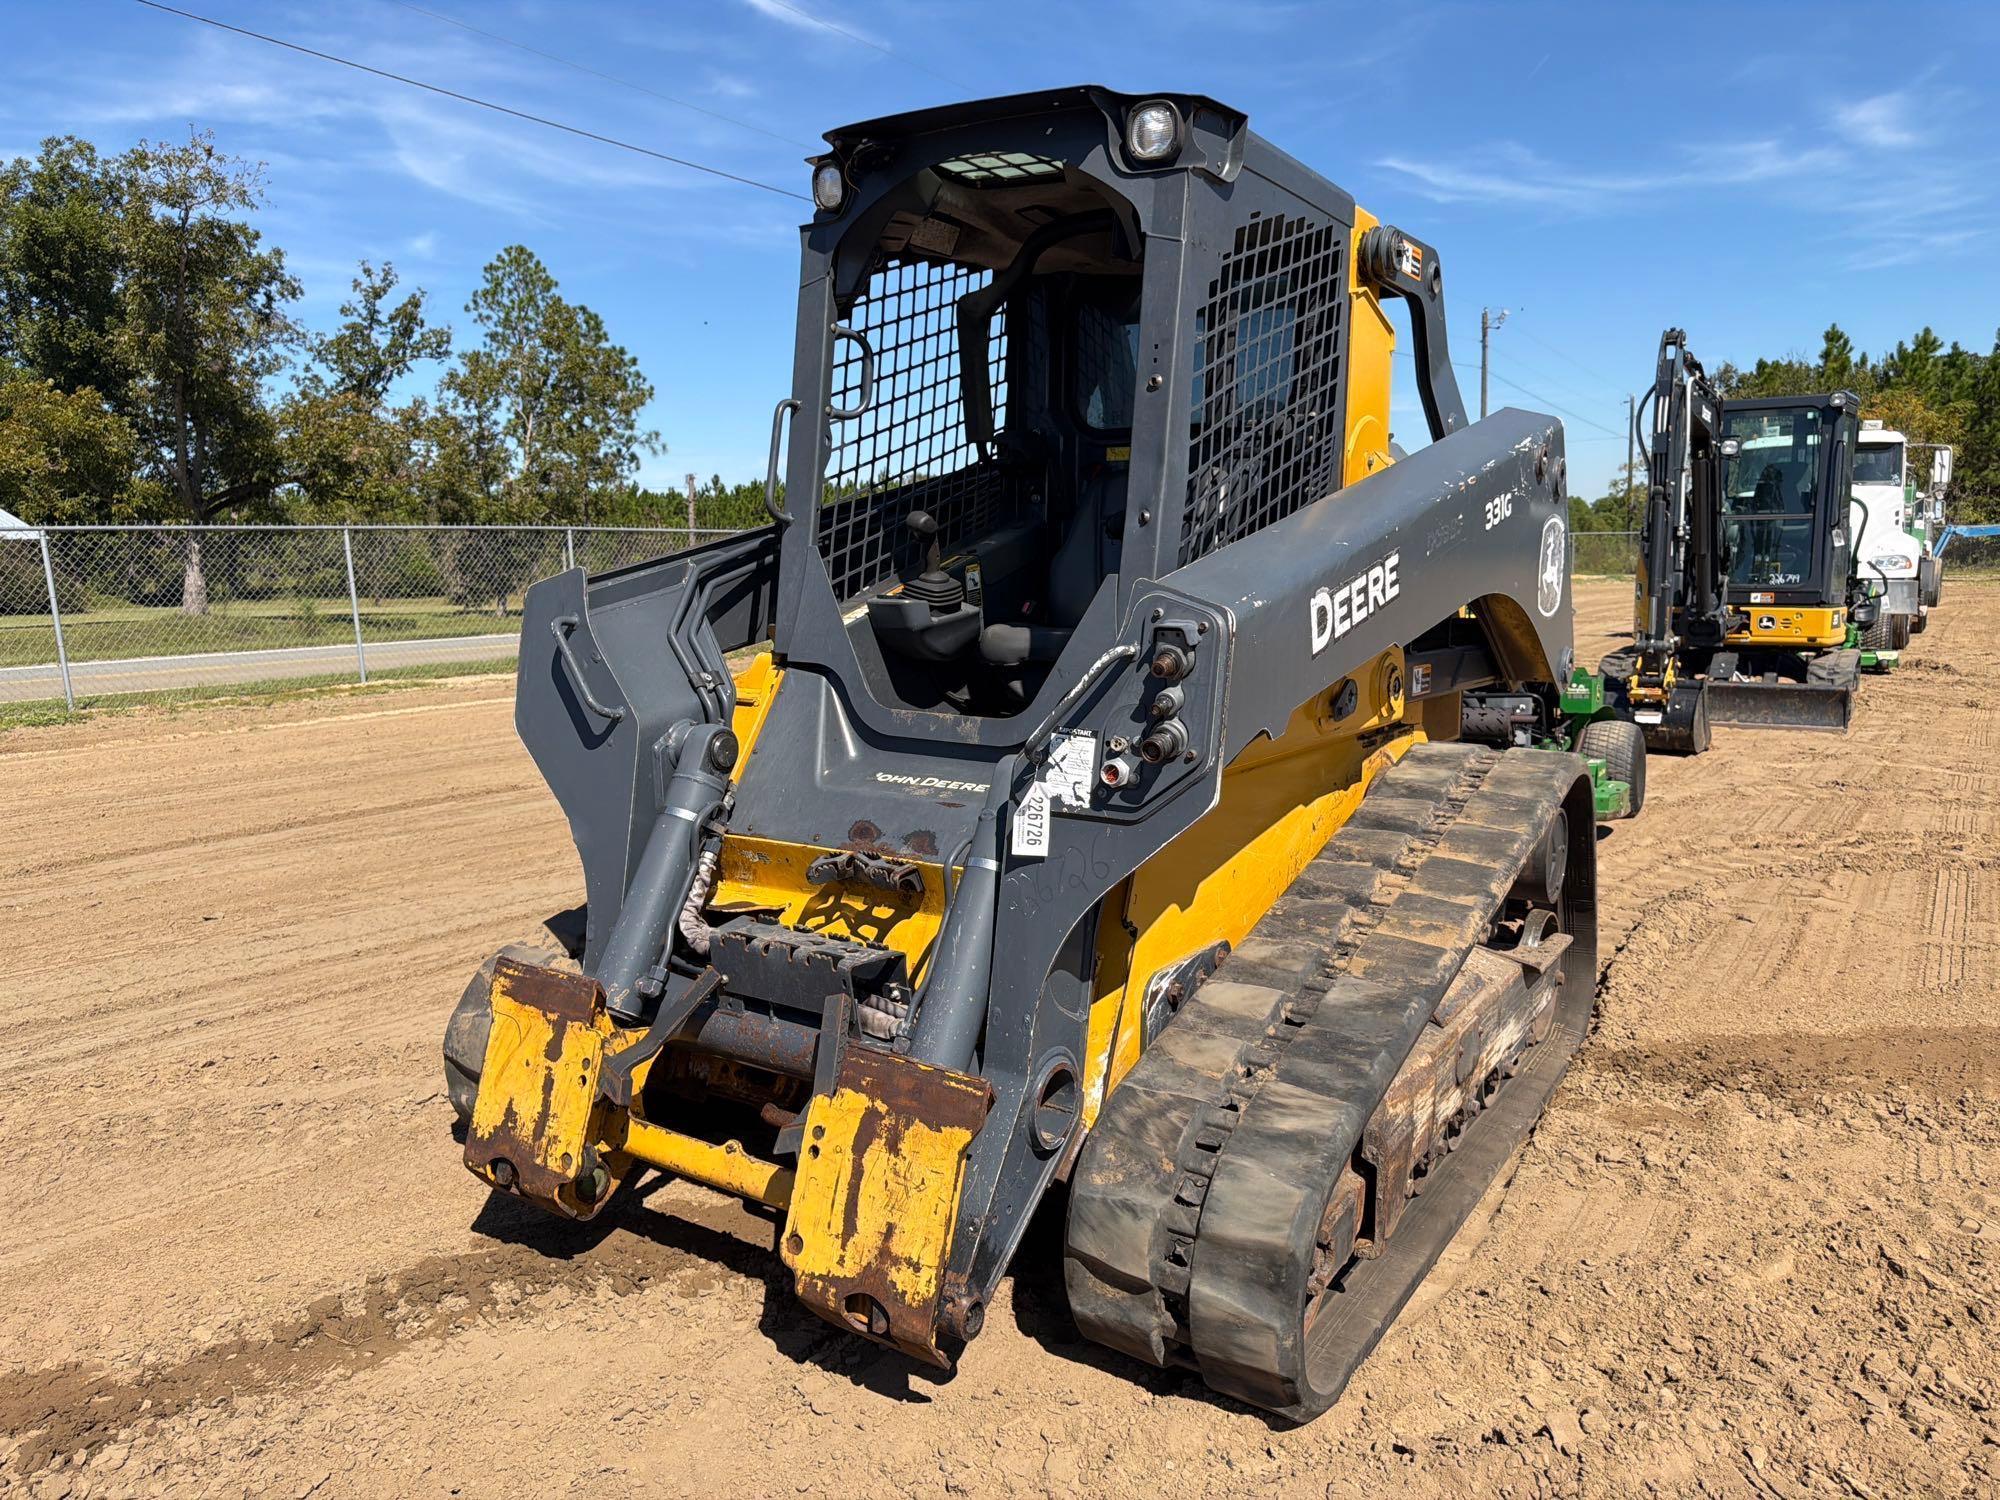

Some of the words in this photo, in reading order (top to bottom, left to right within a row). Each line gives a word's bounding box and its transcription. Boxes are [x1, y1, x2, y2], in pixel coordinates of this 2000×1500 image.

[1485, 493, 1512, 530] 331G
[1310, 552, 1400, 655] DEERE
[919, 777, 991, 792] DEERE
[1026, 796, 1044, 846] 226726
